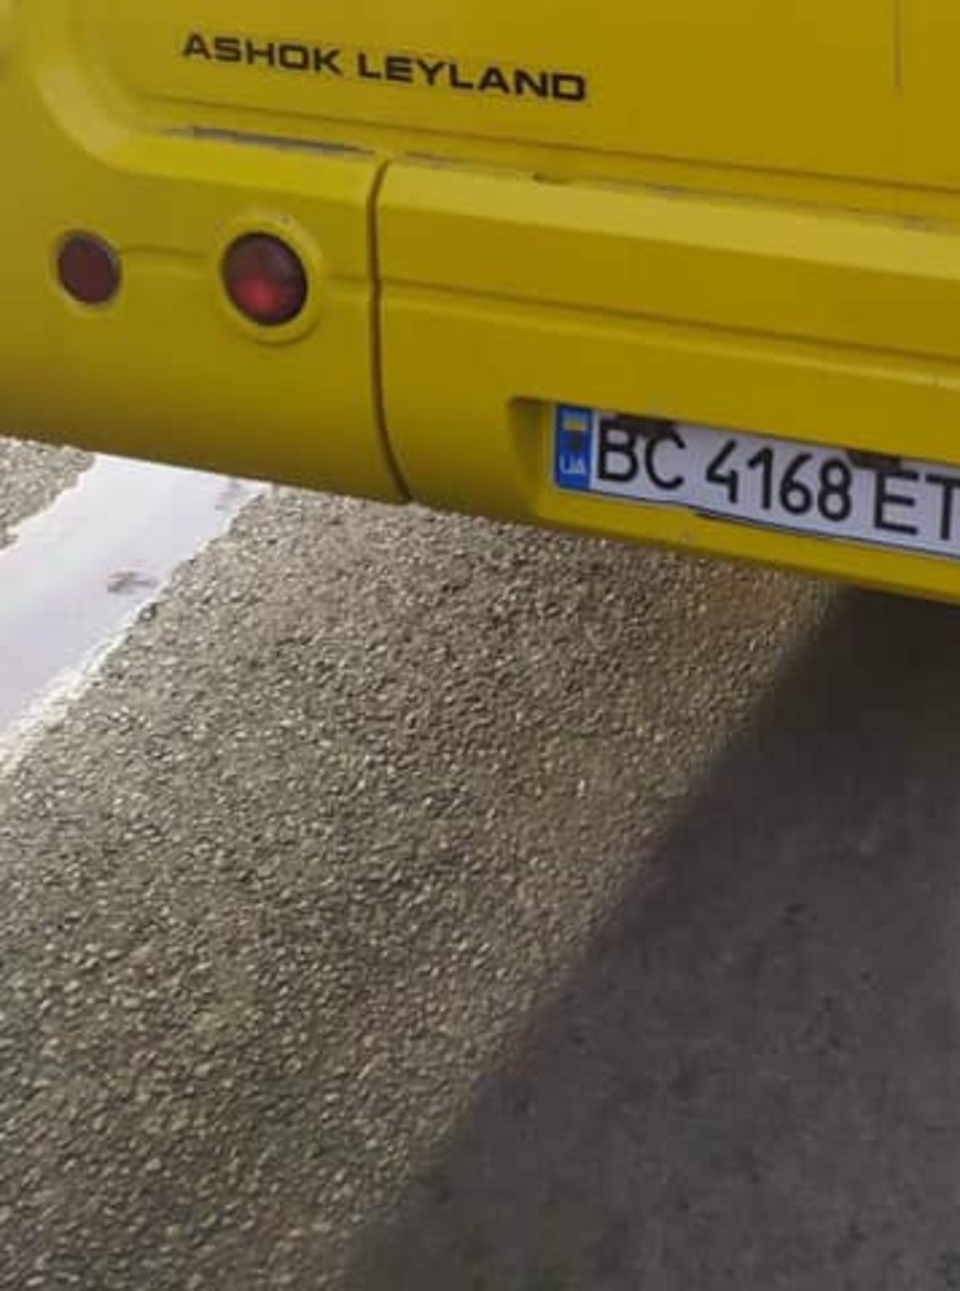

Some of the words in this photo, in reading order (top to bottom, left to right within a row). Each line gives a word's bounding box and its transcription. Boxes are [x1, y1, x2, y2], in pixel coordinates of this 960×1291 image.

[182, 31, 342, 76] ASHOK
[357, 52, 587, 103] LEYLAND
[596, 420, 686, 491] BC
[706, 438, 853, 522] 4168
